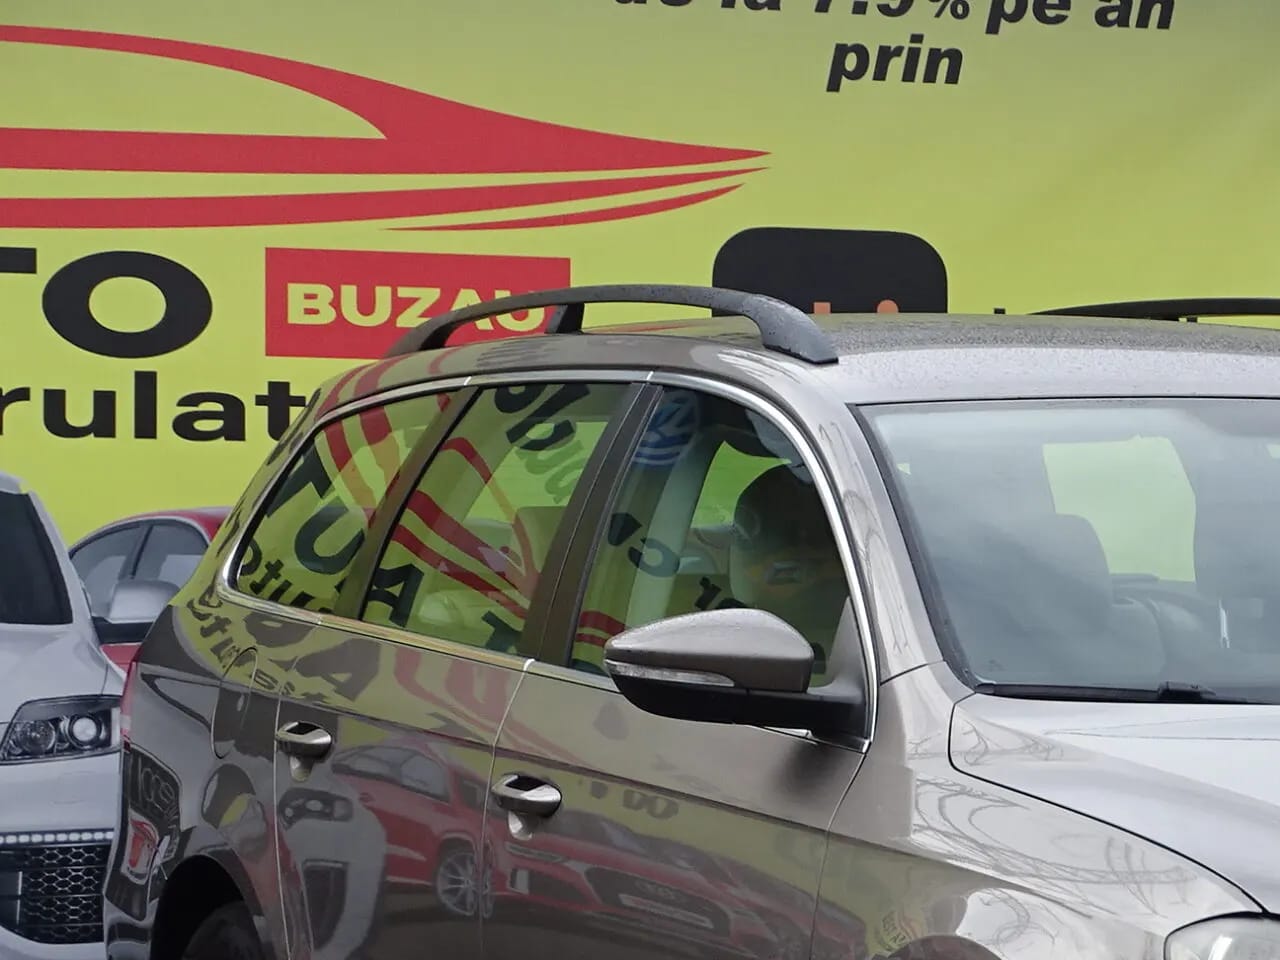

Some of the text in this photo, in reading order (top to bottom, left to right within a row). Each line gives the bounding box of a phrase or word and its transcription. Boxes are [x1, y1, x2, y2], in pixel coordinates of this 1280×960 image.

[985, 0, 1071, 35] pe
[1094, 0, 1175, 30] an
[826, 33, 963, 93] prin
